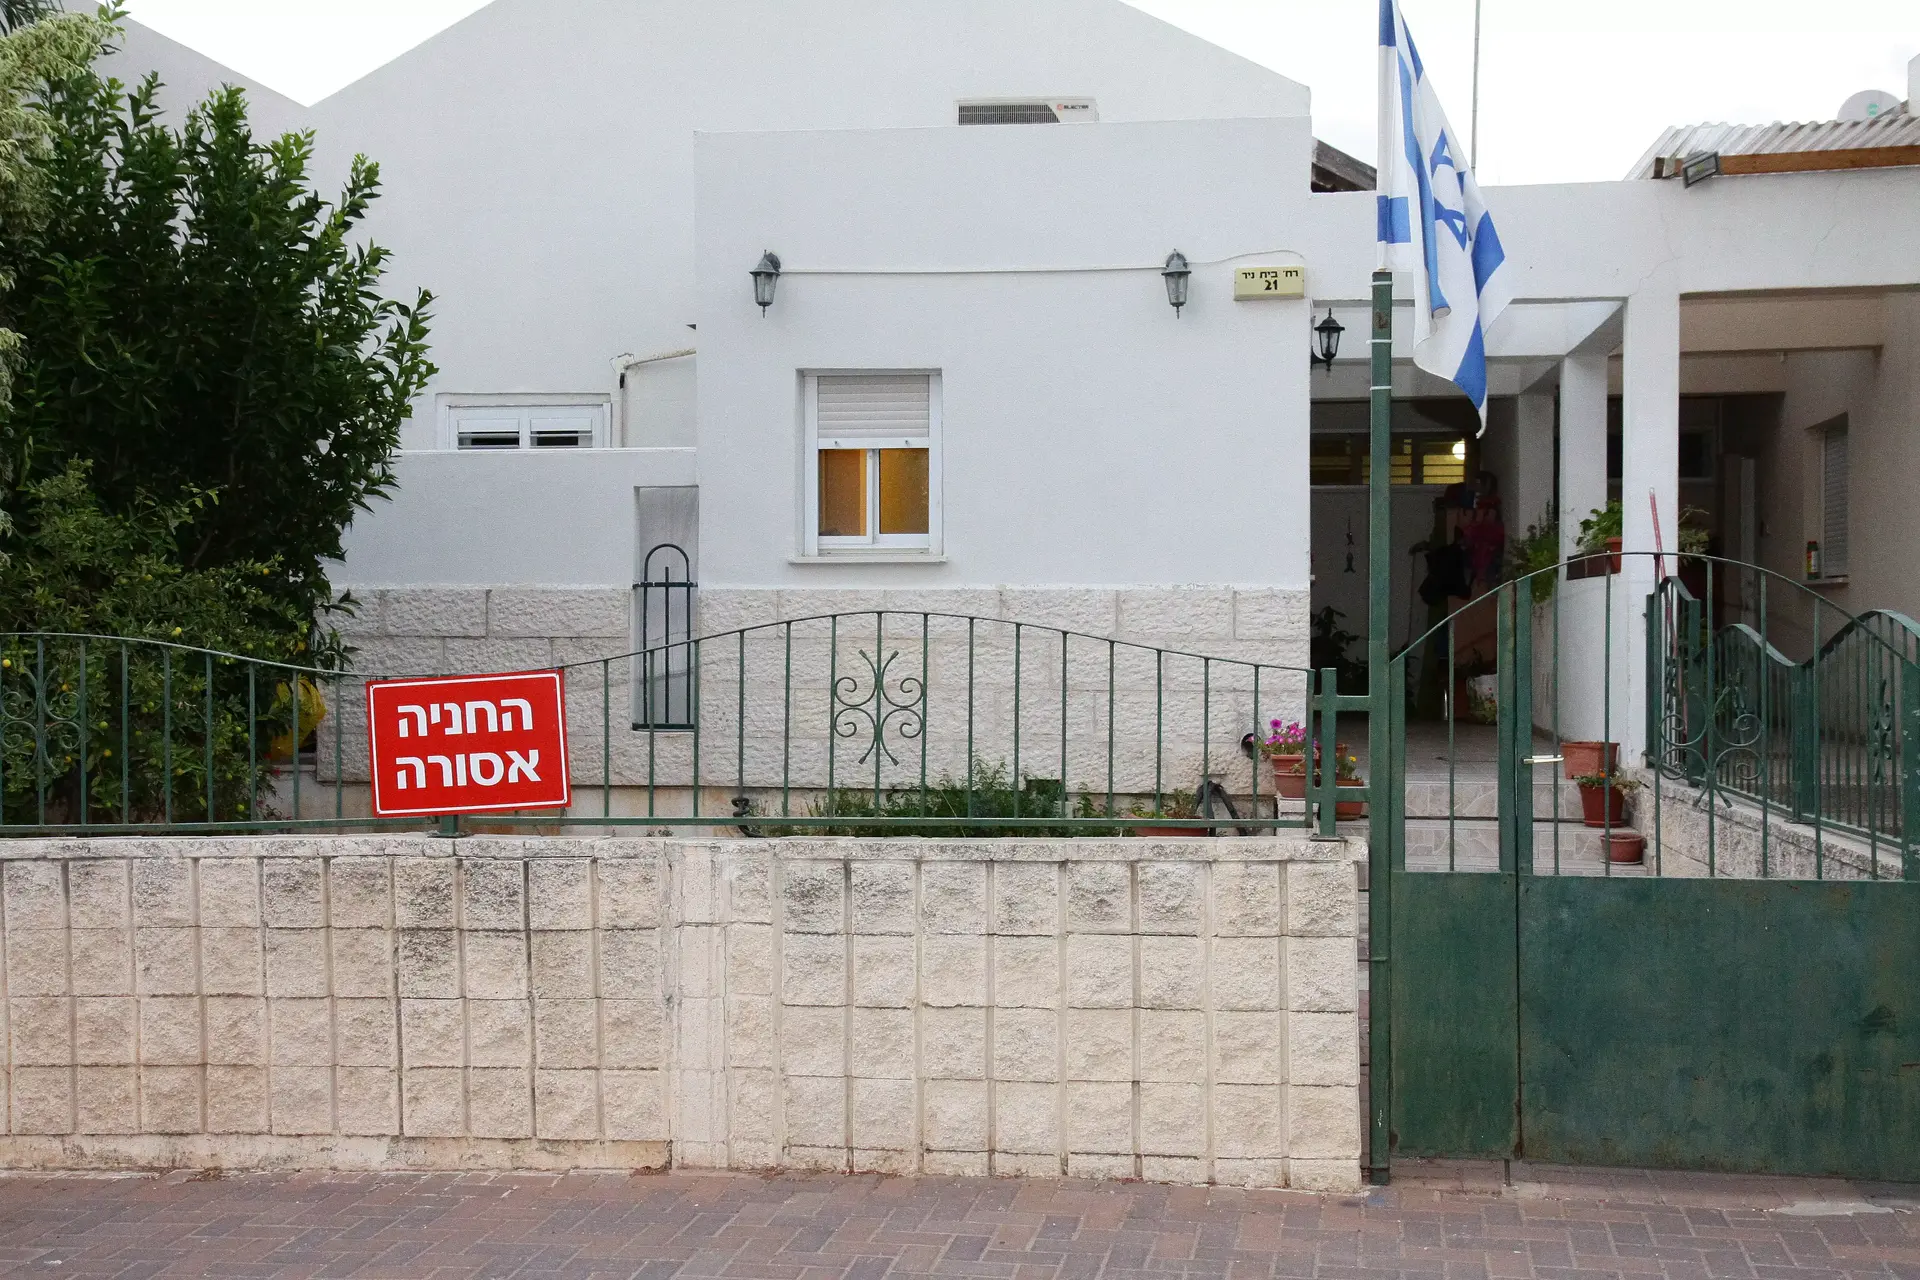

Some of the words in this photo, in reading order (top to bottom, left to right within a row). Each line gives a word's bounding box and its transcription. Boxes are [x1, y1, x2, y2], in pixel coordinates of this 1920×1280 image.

[1264, 279, 1278, 290] 21
[397, 698, 533, 738] החניה
[395, 749, 542, 790] אסורה
